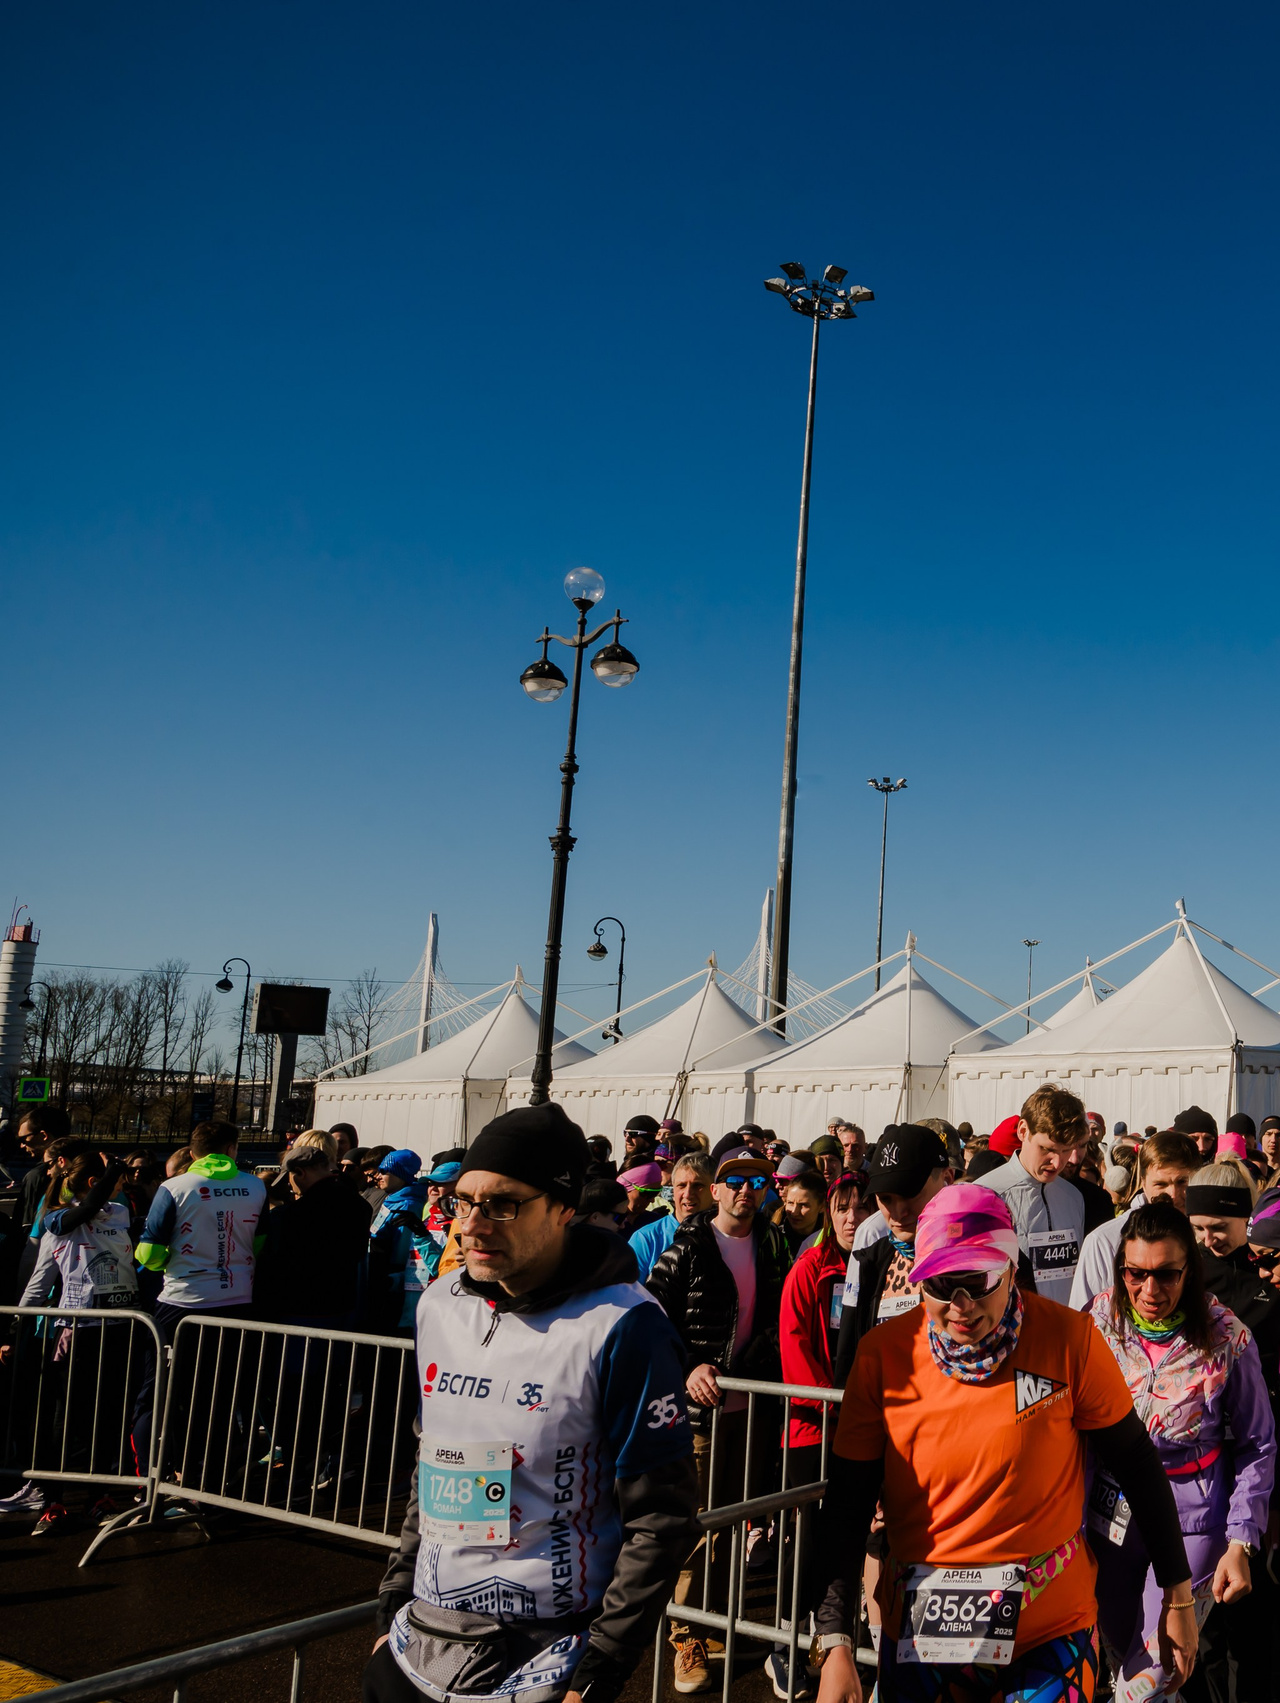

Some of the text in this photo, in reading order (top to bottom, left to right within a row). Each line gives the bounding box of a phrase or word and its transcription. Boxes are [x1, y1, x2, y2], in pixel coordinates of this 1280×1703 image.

[880, 1142, 900, 1167] NY
[213, 1187, 250, 1198] БСПБ
[216, 1210, 225, 1232] БСПБ
[1043, 1246, 1069, 1261] 4441
[107, 1293, 132, 1303] 4061
[895, 1299, 917, 1308] АРЕНА
[437, 1371, 492, 1399] БСПБ
[516, 1382, 544, 1407] 35
[1016, 1370, 1053, 1413] KVS
[647, 1392, 679, 1429] 35
[1016, 1408, 1036, 1426] НАМ
[1042, 1398, 1053, 1410] 20
[1054, 1387, 1070, 1402] ЛЕТ
[435, 1448, 464, 1460] АРЕНА
[554, 1446, 576, 1504] БСПБ
[430, 1474, 473, 1504] 1748
[433, 1502, 462, 1514] РОМАН
[483, 1508, 505, 1517] 2025
[943, 1570, 1013, 1581] АРЕНА 10
[925, 1594, 993, 1622] 3562
[939, 1622, 973, 1633] АЛЕНА
[994, 1627, 1013, 1636] 2025
